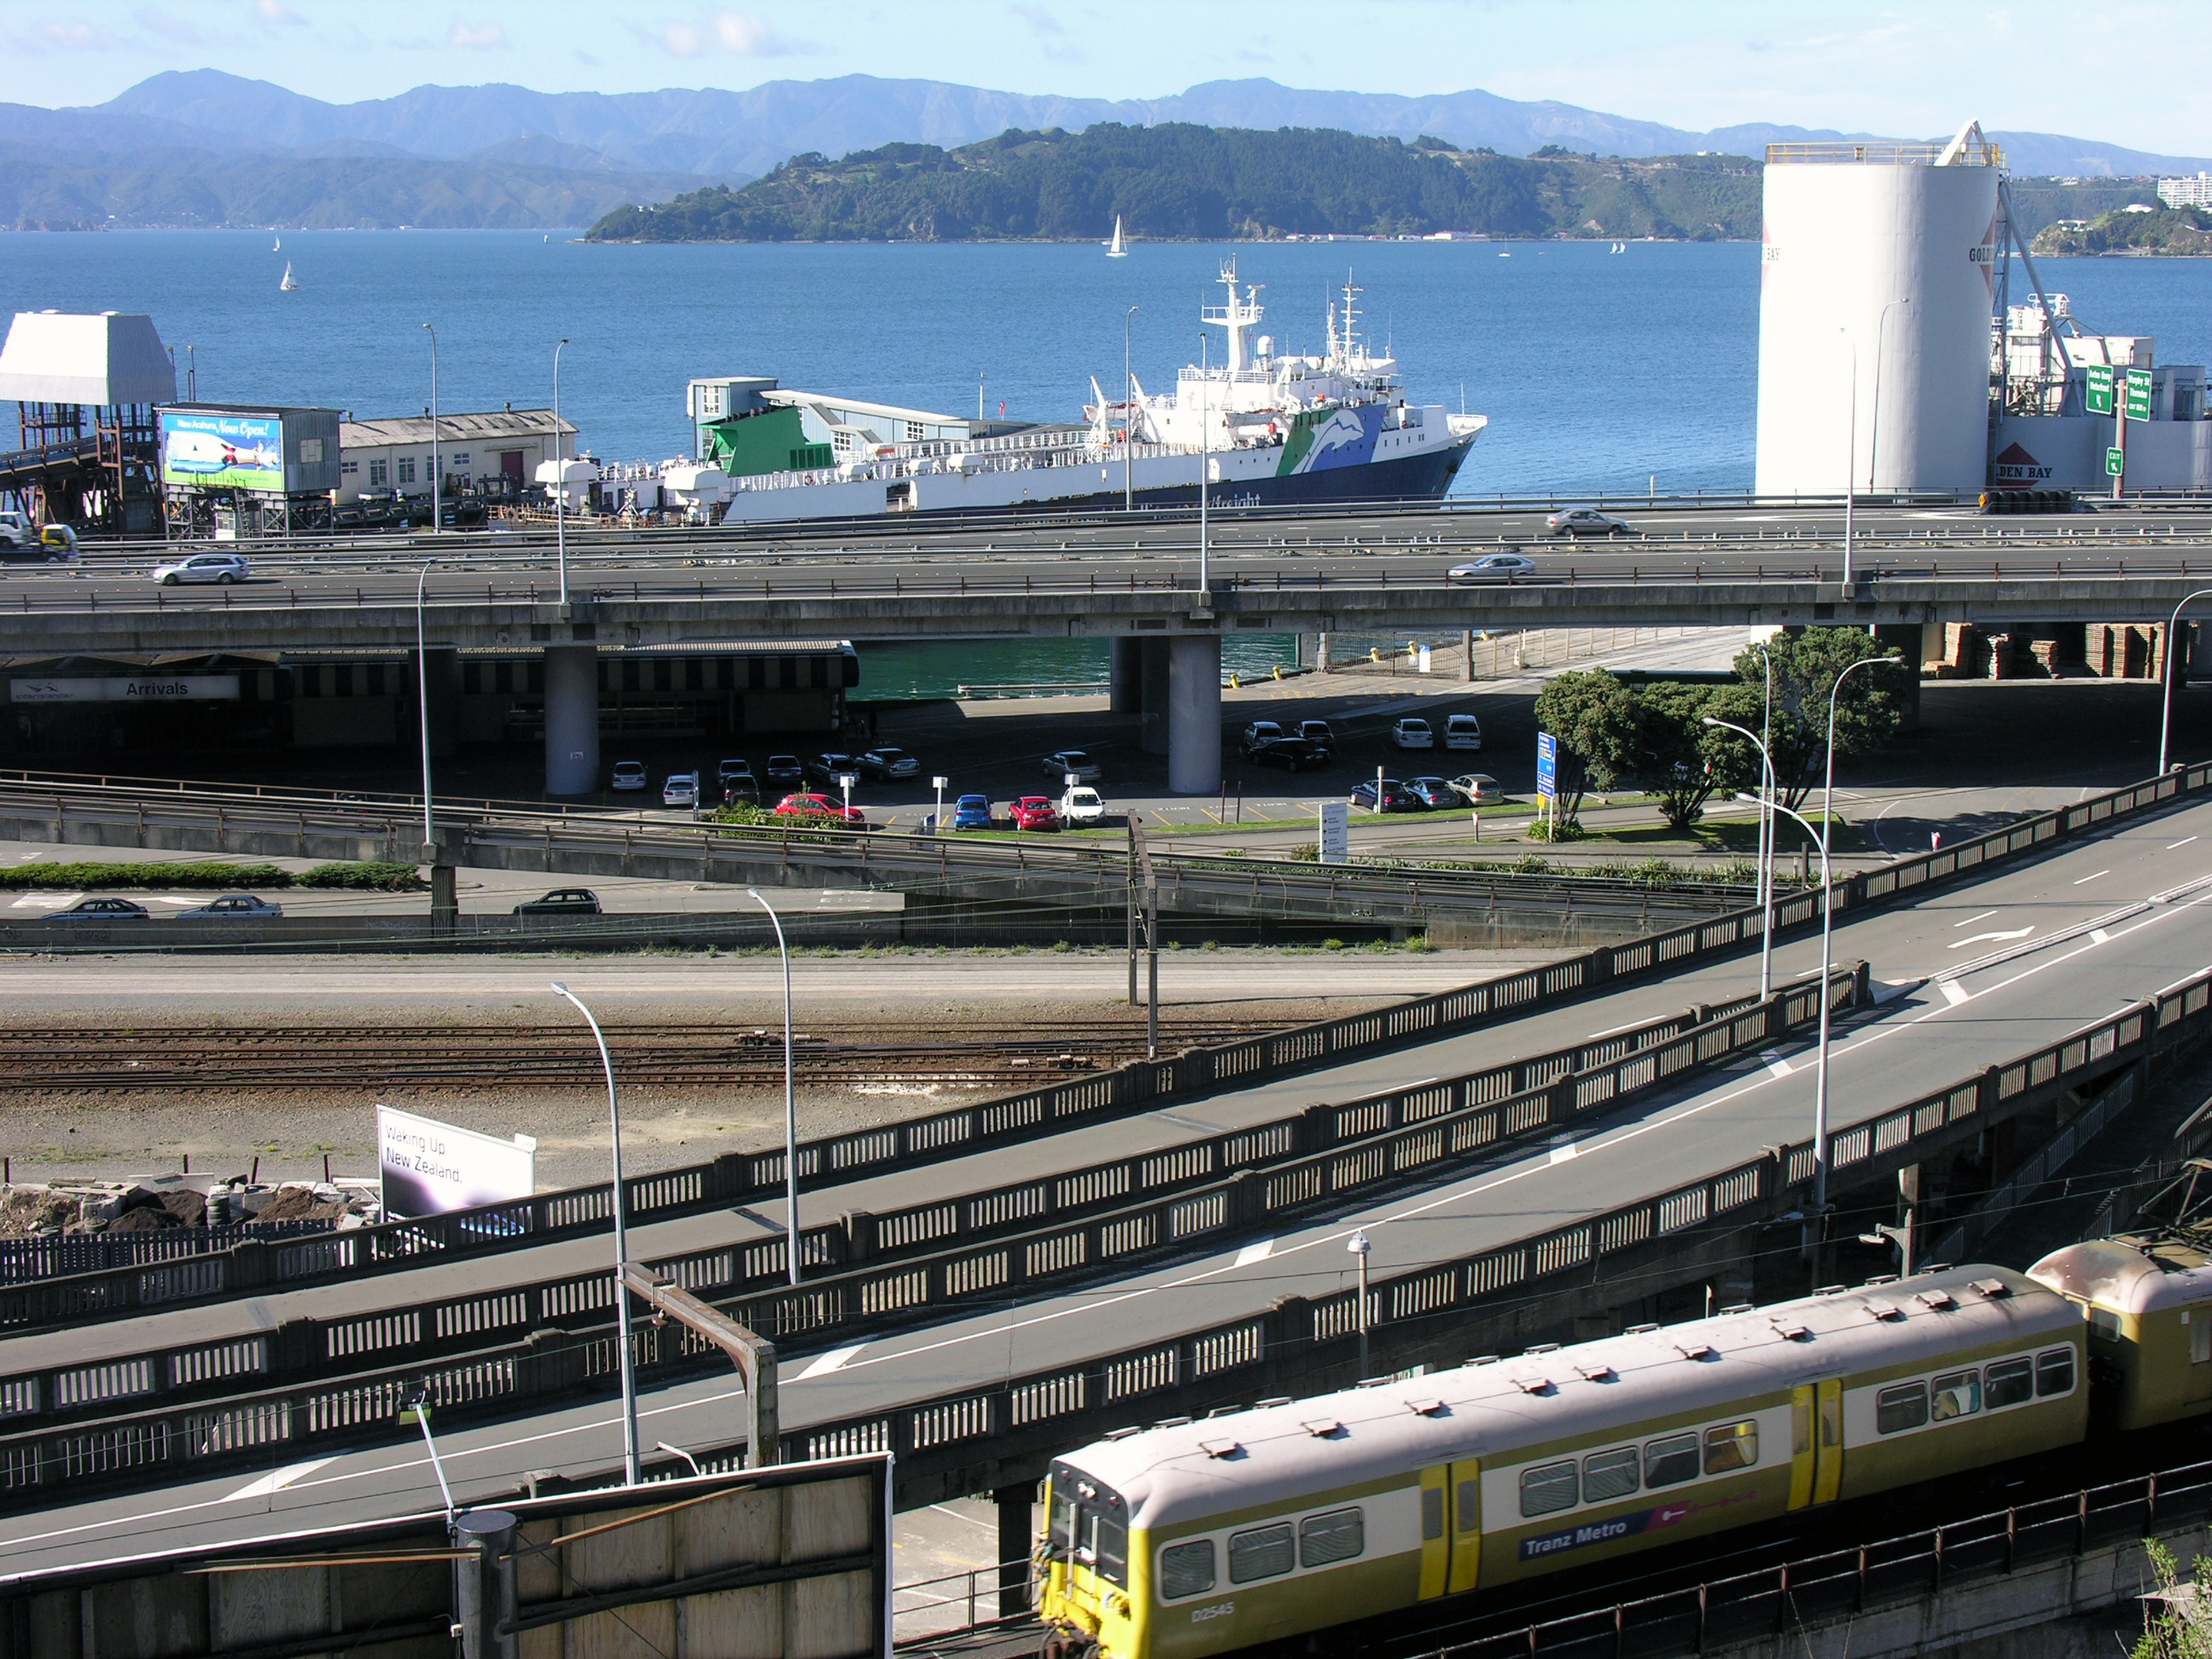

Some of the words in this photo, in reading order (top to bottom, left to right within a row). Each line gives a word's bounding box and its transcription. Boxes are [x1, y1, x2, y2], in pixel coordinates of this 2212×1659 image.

[178, 419, 191, 428] New
[216, 420, 239, 434] Now
[240, 421, 270, 439] Open!
[2028, 467, 2052, 478] BAY
[126, 682, 189, 696] Arrivals
[386, 1125, 425, 1152] Waking
[429, 1137, 445, 1155] Up
[387, 1147, 410, 1168] New
[1526, 1534, 1572, 1556] Tranz
[1576, 1520, 1627, 1544] Metro
